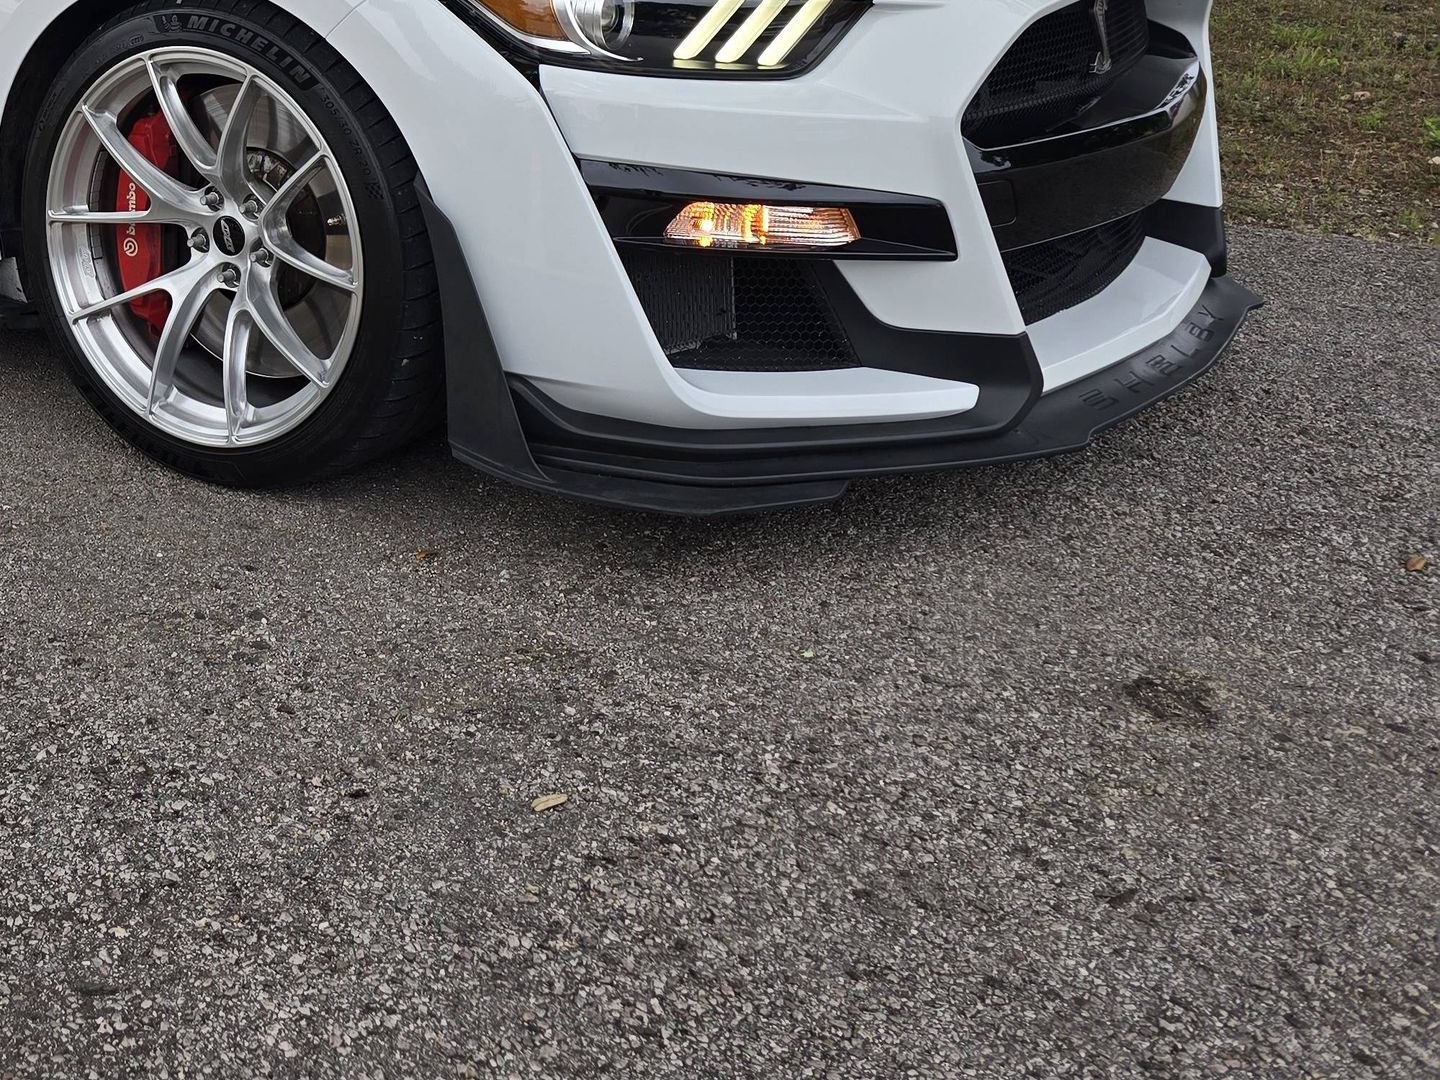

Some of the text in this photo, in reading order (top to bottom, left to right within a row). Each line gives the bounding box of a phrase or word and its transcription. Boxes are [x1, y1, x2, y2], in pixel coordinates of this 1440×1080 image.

[187, 15, 312, 83] MICHELIN
[126, 182, 137, 236] brmbo
[1079, 305, 1225, 411] SHELBY
